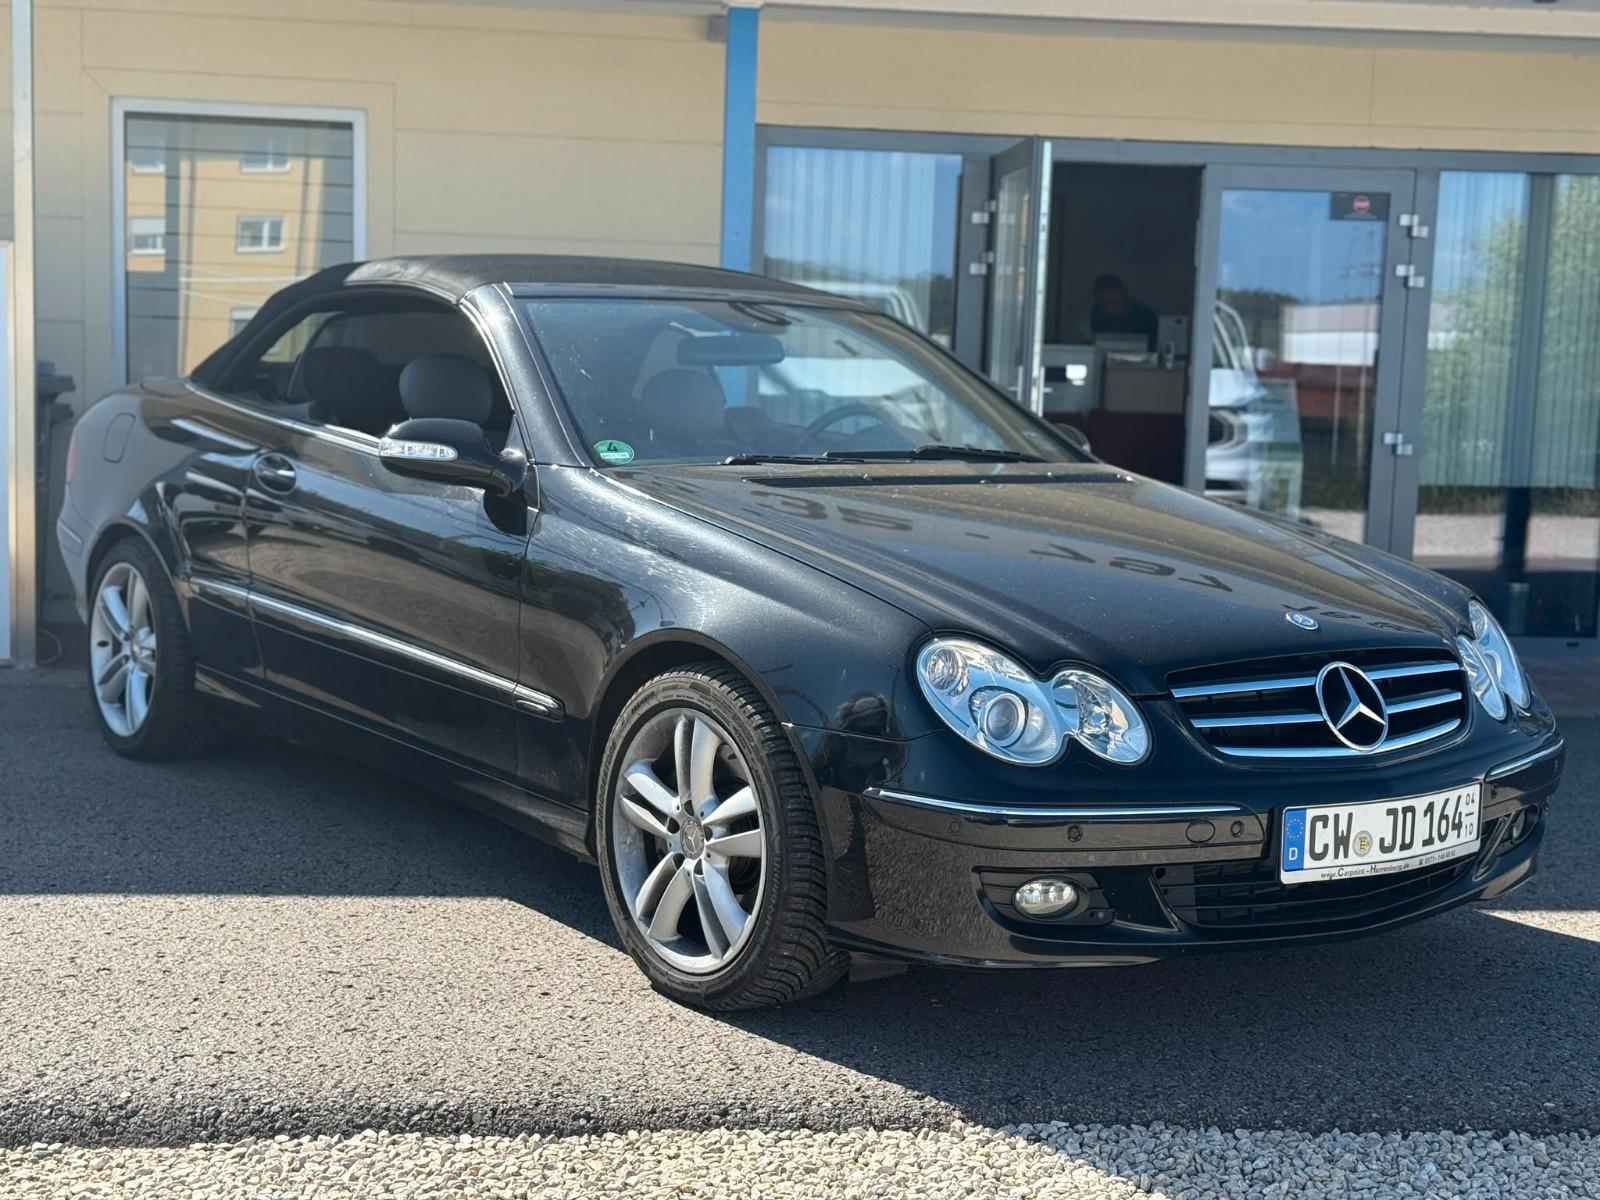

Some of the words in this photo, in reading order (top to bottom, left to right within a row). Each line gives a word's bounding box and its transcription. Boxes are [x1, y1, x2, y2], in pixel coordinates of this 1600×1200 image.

[607, 441, 618, 452] 4
[1465, 793, 1475, 806] 04
[1309, 812, 1353, 861] CW
[1379, 805, 1416, 854] JD
[1422, 794, 1462, 847] 164
[1464, 822, 1474, 837] 10
[1288, 847, 1298, 860] D
